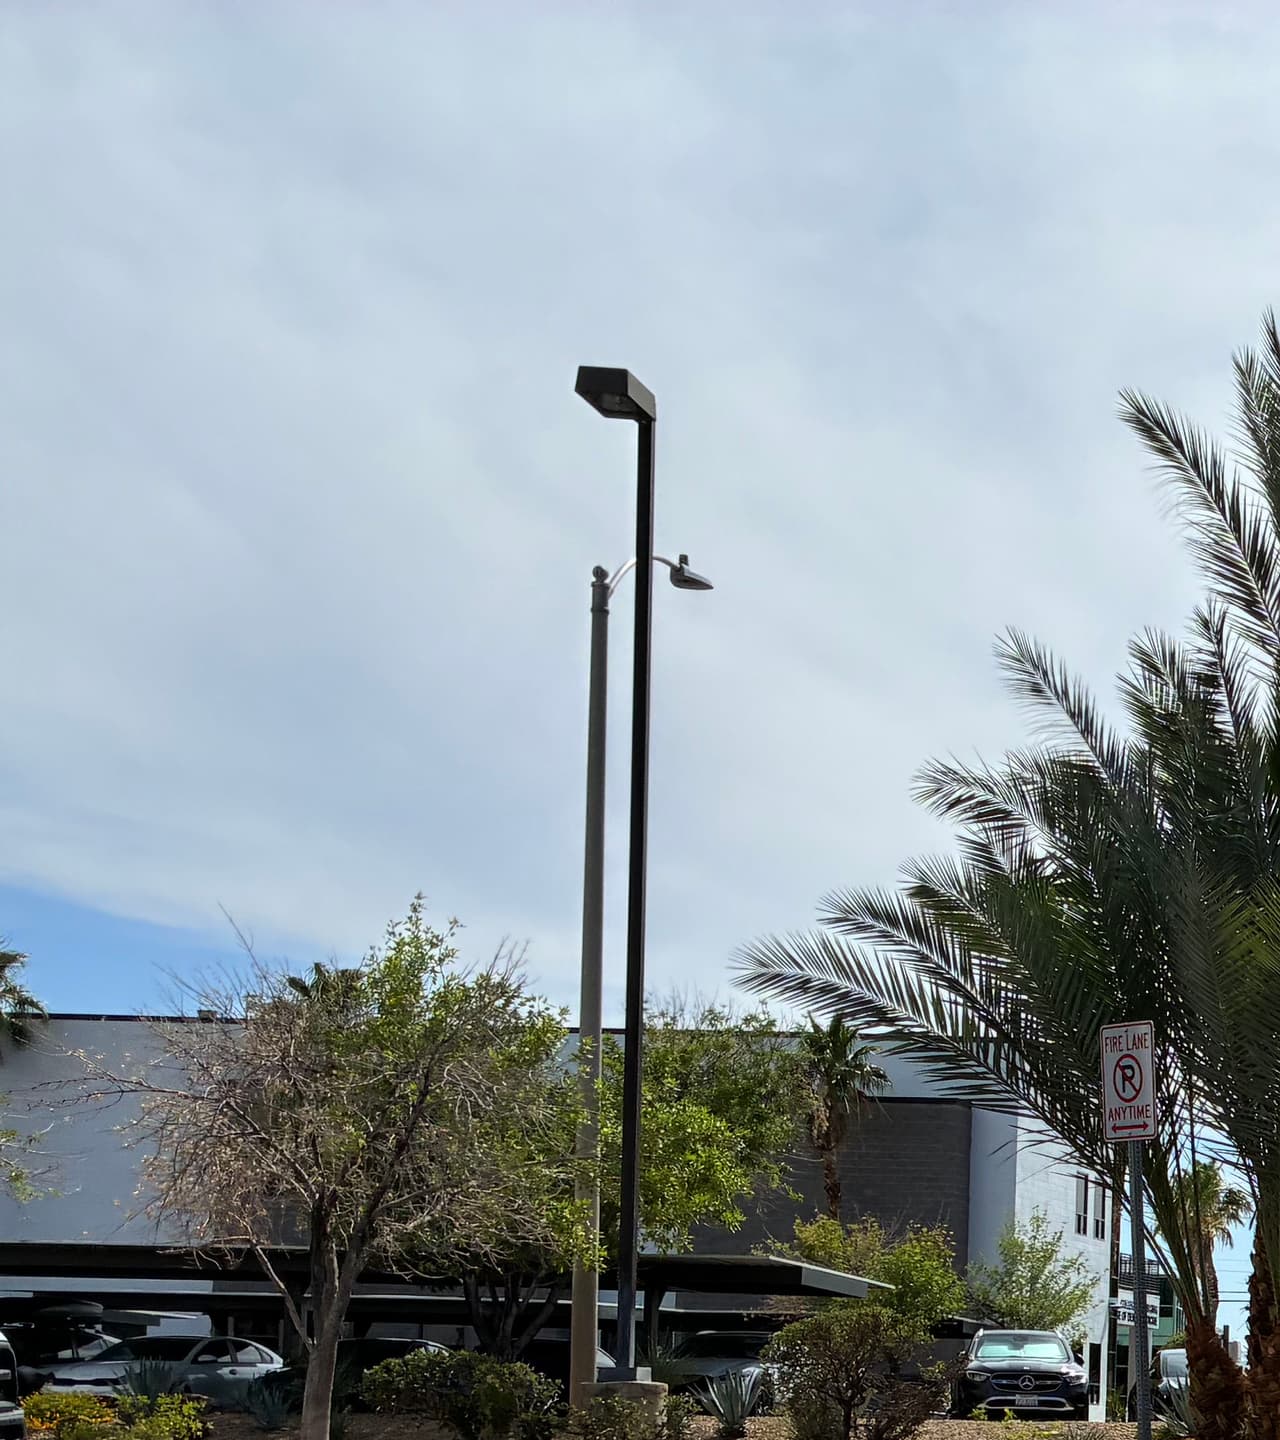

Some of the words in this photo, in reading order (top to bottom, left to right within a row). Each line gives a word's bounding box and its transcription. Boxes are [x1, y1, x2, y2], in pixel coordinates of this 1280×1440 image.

[1105, 1035, 1124, 1053] FIRE
[1125, 1032, 1149, 1051] LANE
[1108, 1104, 1152, 1122] ANYTIME
